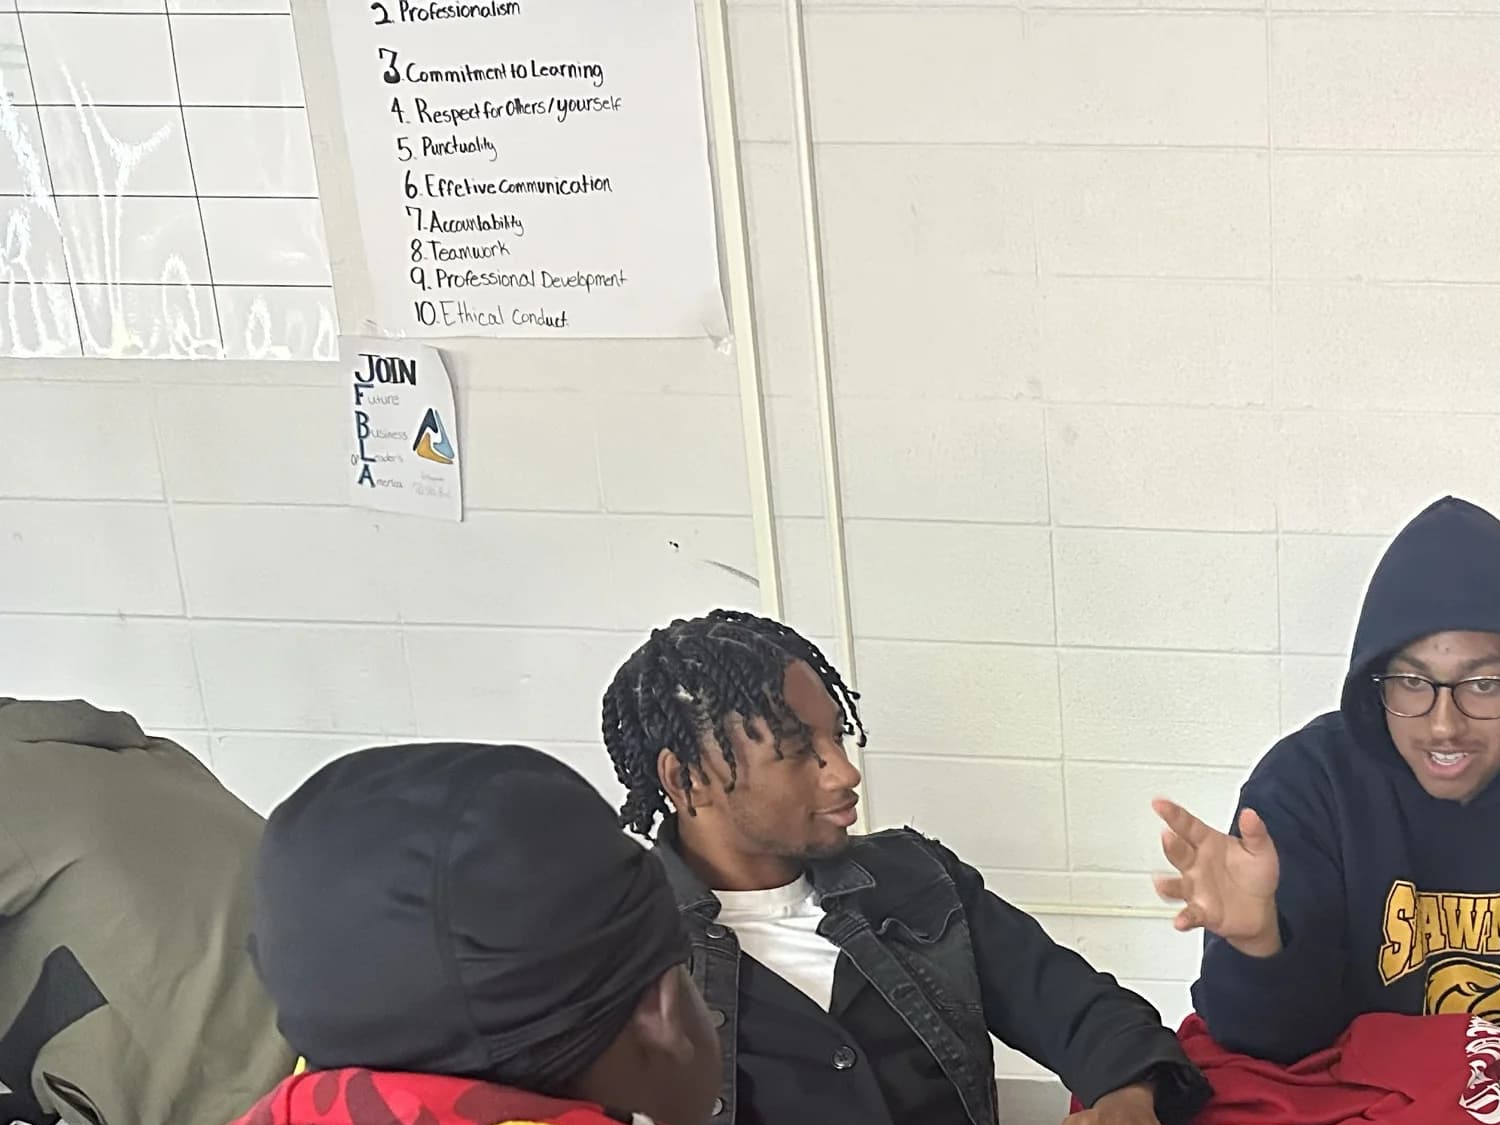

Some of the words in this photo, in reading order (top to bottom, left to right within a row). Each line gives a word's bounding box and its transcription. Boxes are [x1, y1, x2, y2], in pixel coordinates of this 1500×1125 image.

[399, 0, 520, 22] Professionalism
[406, 62, 507, 83] Commitment
[510, 63, 528, 79] to
[531, 60, 604, 87] Learning
[415, 97, 480, 126] Respect
[484, 101, 503, 118] for
[421, 134, 498, 162] Punctuality
[498, 174, 613, 195] Communication
[429, 210, 524, 237] Accountability
[426, 240, 510, 261] Teamwork
[436, 268, 535, 288] Professional
[541, 269, 628, 293] Development
[440, 300, 504, 326] Ethical
[355, 354, 416, 385] JOIN
